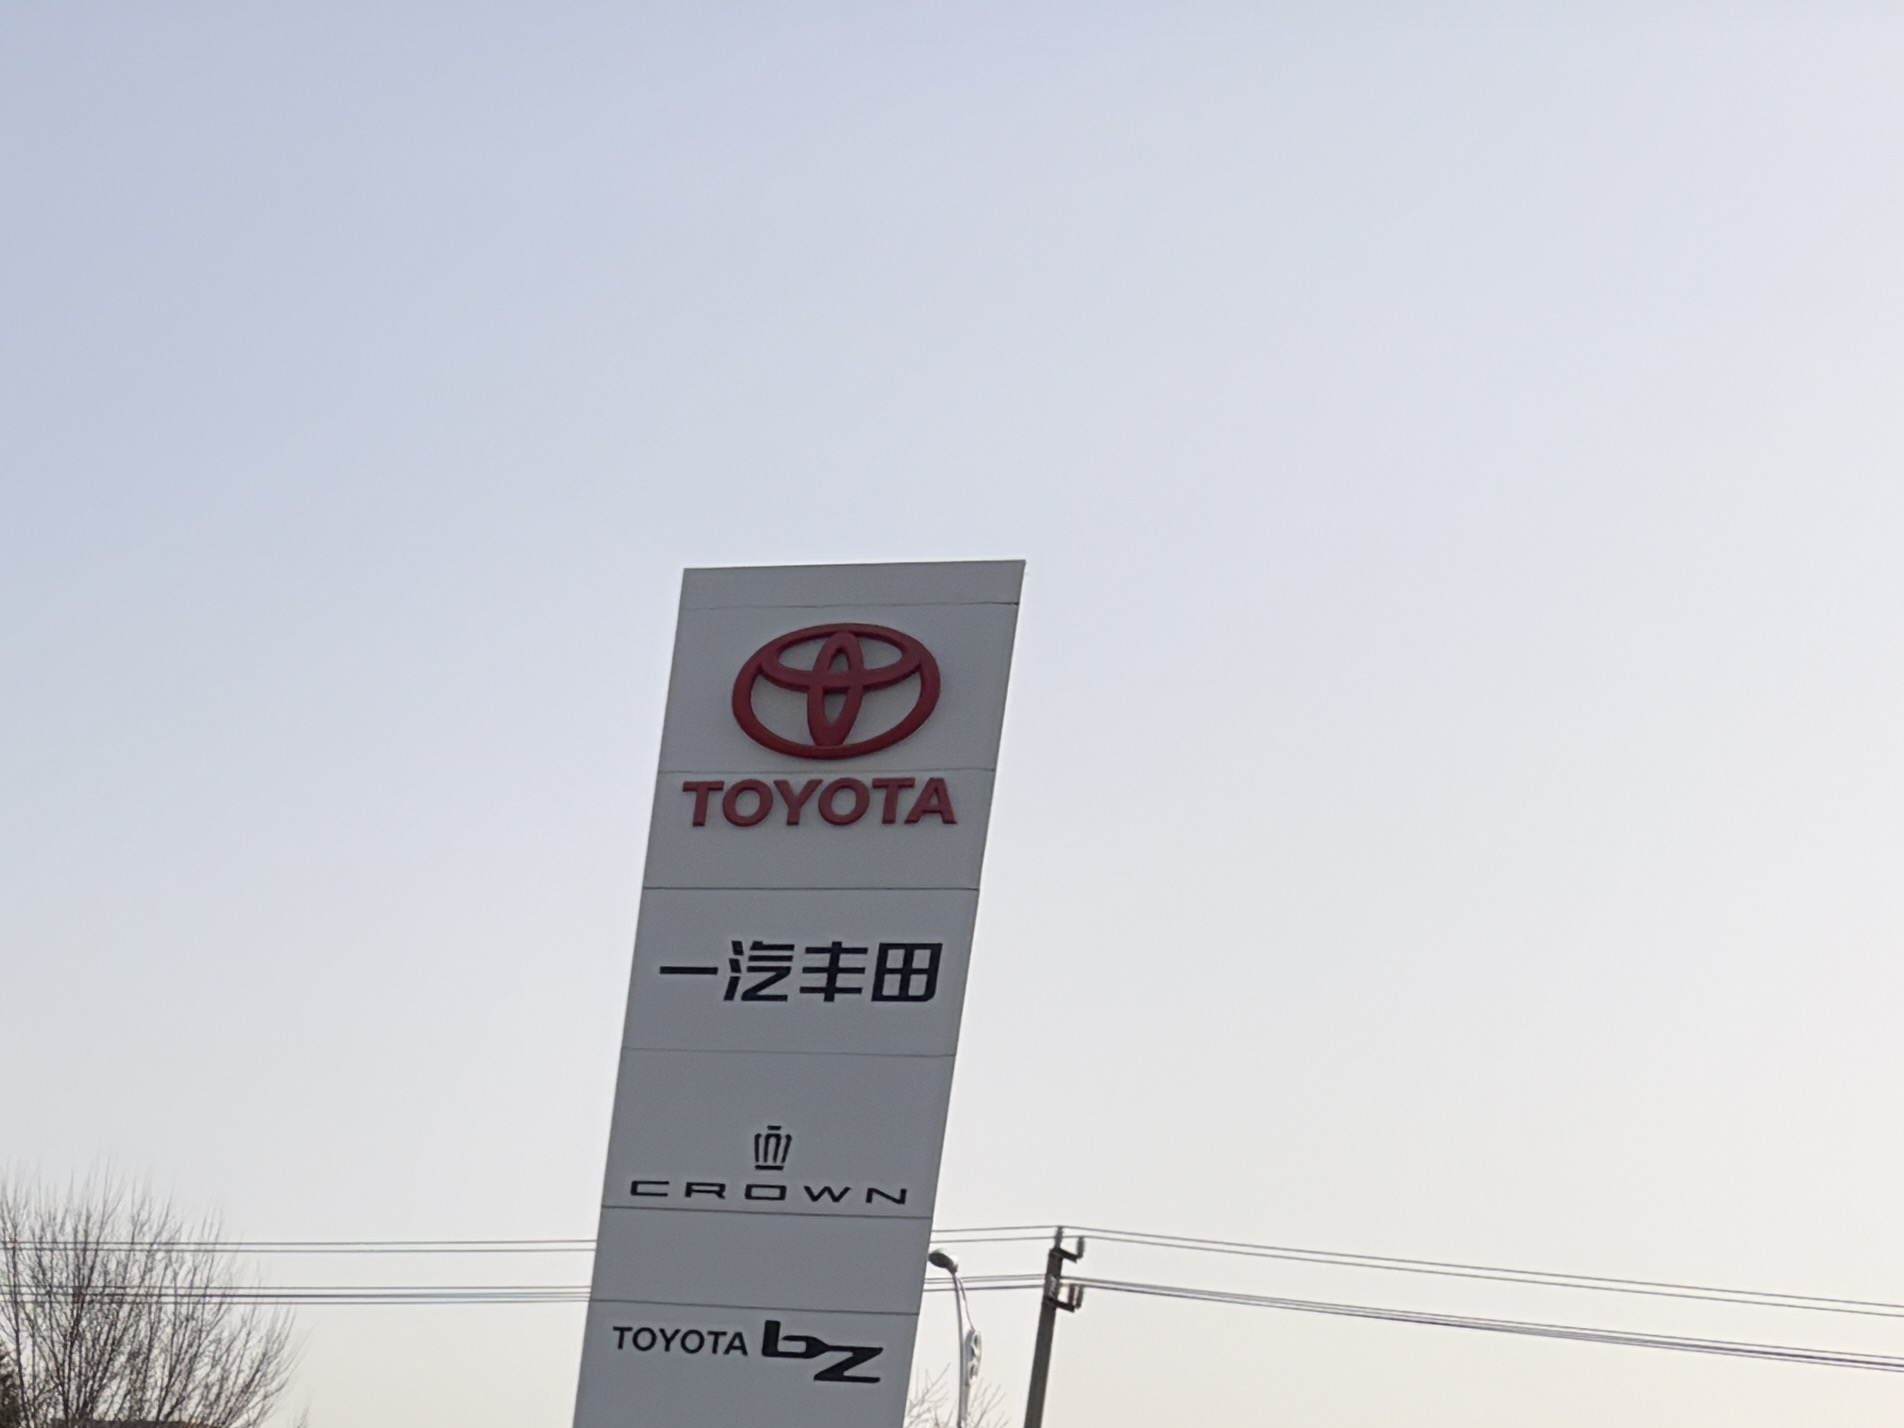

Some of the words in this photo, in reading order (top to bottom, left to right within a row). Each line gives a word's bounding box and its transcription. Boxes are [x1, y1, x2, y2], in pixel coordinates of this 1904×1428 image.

[682, 777, 957, 827] TOYOTA
[659, 940, 943, 1003] 一汽丰田
[629, 1179, 908, 1206] CROWN
[612, 1326, 749, 1359] TOYOTA
